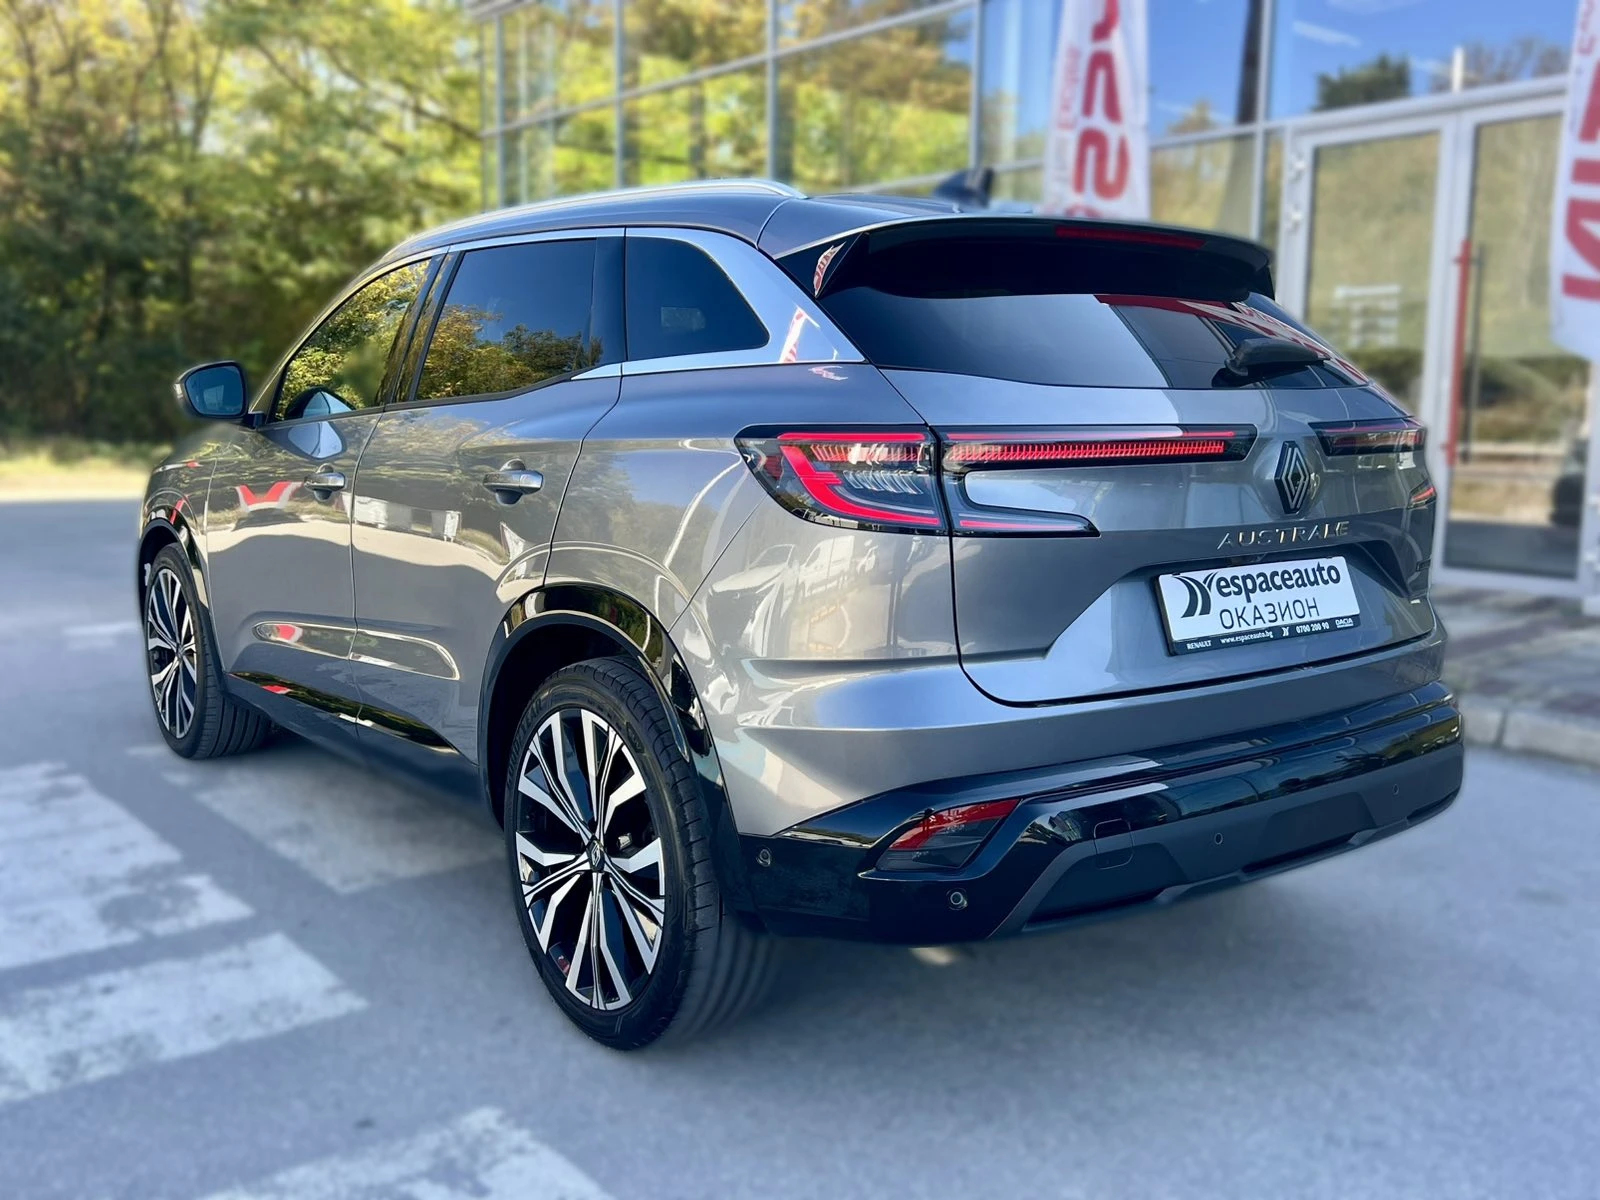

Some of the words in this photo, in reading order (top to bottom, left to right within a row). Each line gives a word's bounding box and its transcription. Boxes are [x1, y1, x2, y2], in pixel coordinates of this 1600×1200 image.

[1217, 521, 1351, 550] AUSTRALE
[1216, 562, 1341, 603] espaceauto
[1219, 597, 1320, 630] ОКАЗИОН
[1187, 640, 1212, 650] RENAULT
[1220, 630, 1274, 645] www.espaceauto.bg
[1296, 623, 1310, 634] 0700
[1335, 617, 1353, 627] DACIA
